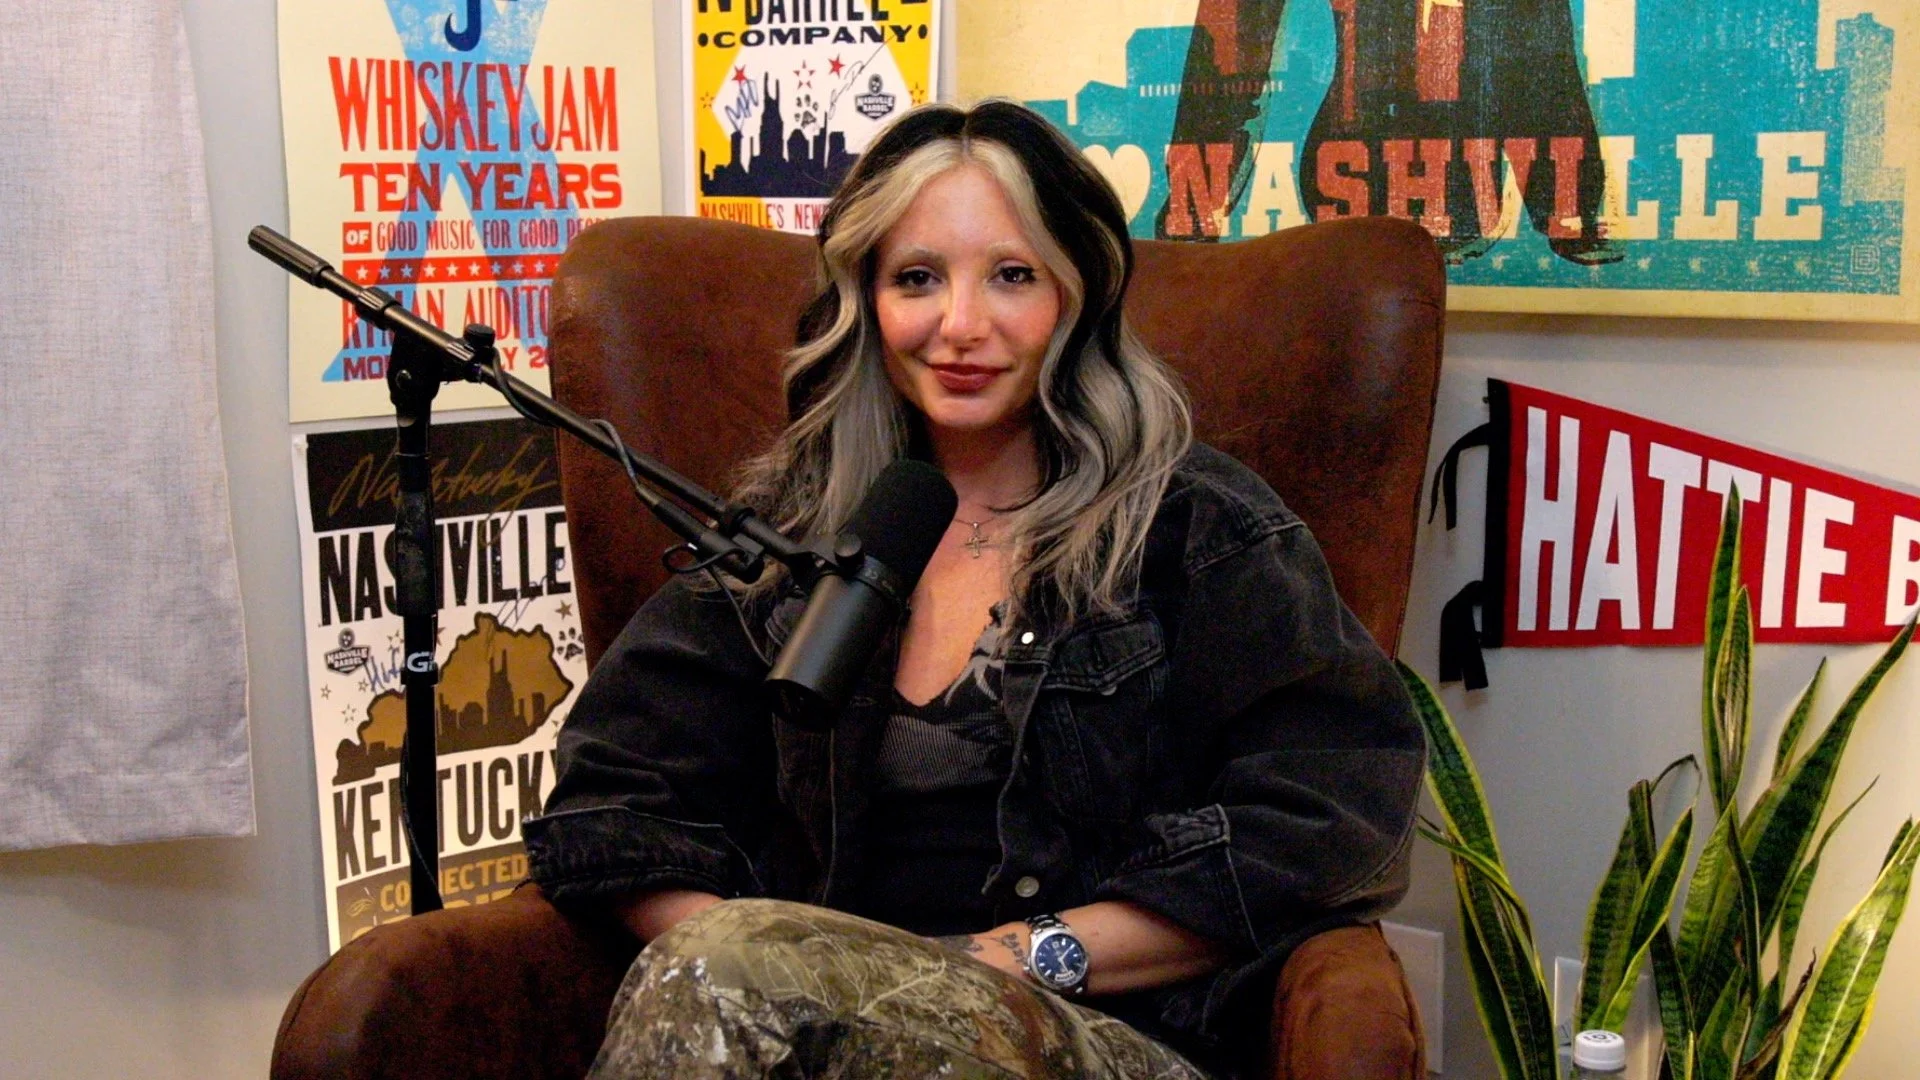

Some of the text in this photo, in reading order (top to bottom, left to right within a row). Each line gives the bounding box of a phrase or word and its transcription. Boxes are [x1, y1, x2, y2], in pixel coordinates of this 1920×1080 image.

[713, 24, 913, 49] COMPANY
[328, 56, 528, 152] WHISKEY
[531, 65, 619, 152] JAM
[340, 162, 623, 213] TEN YEARS
[1164, 130, 1827, 240] NASHVILLE
[346, 229, 370, 246] OF
[376, 220, 418, 253] GOOD
[426, 219, 475, 251] MUSIC
[483, 218, 512, 249] FOR
[519, 217, 559, 249] GOOD
[464, 284, 551, 342] AUDITO
[1517, 405, 1856, 632] HATTIE
[333, 749, 557, 882] KENUCK
[379, 852, 529, 913] COECTED
